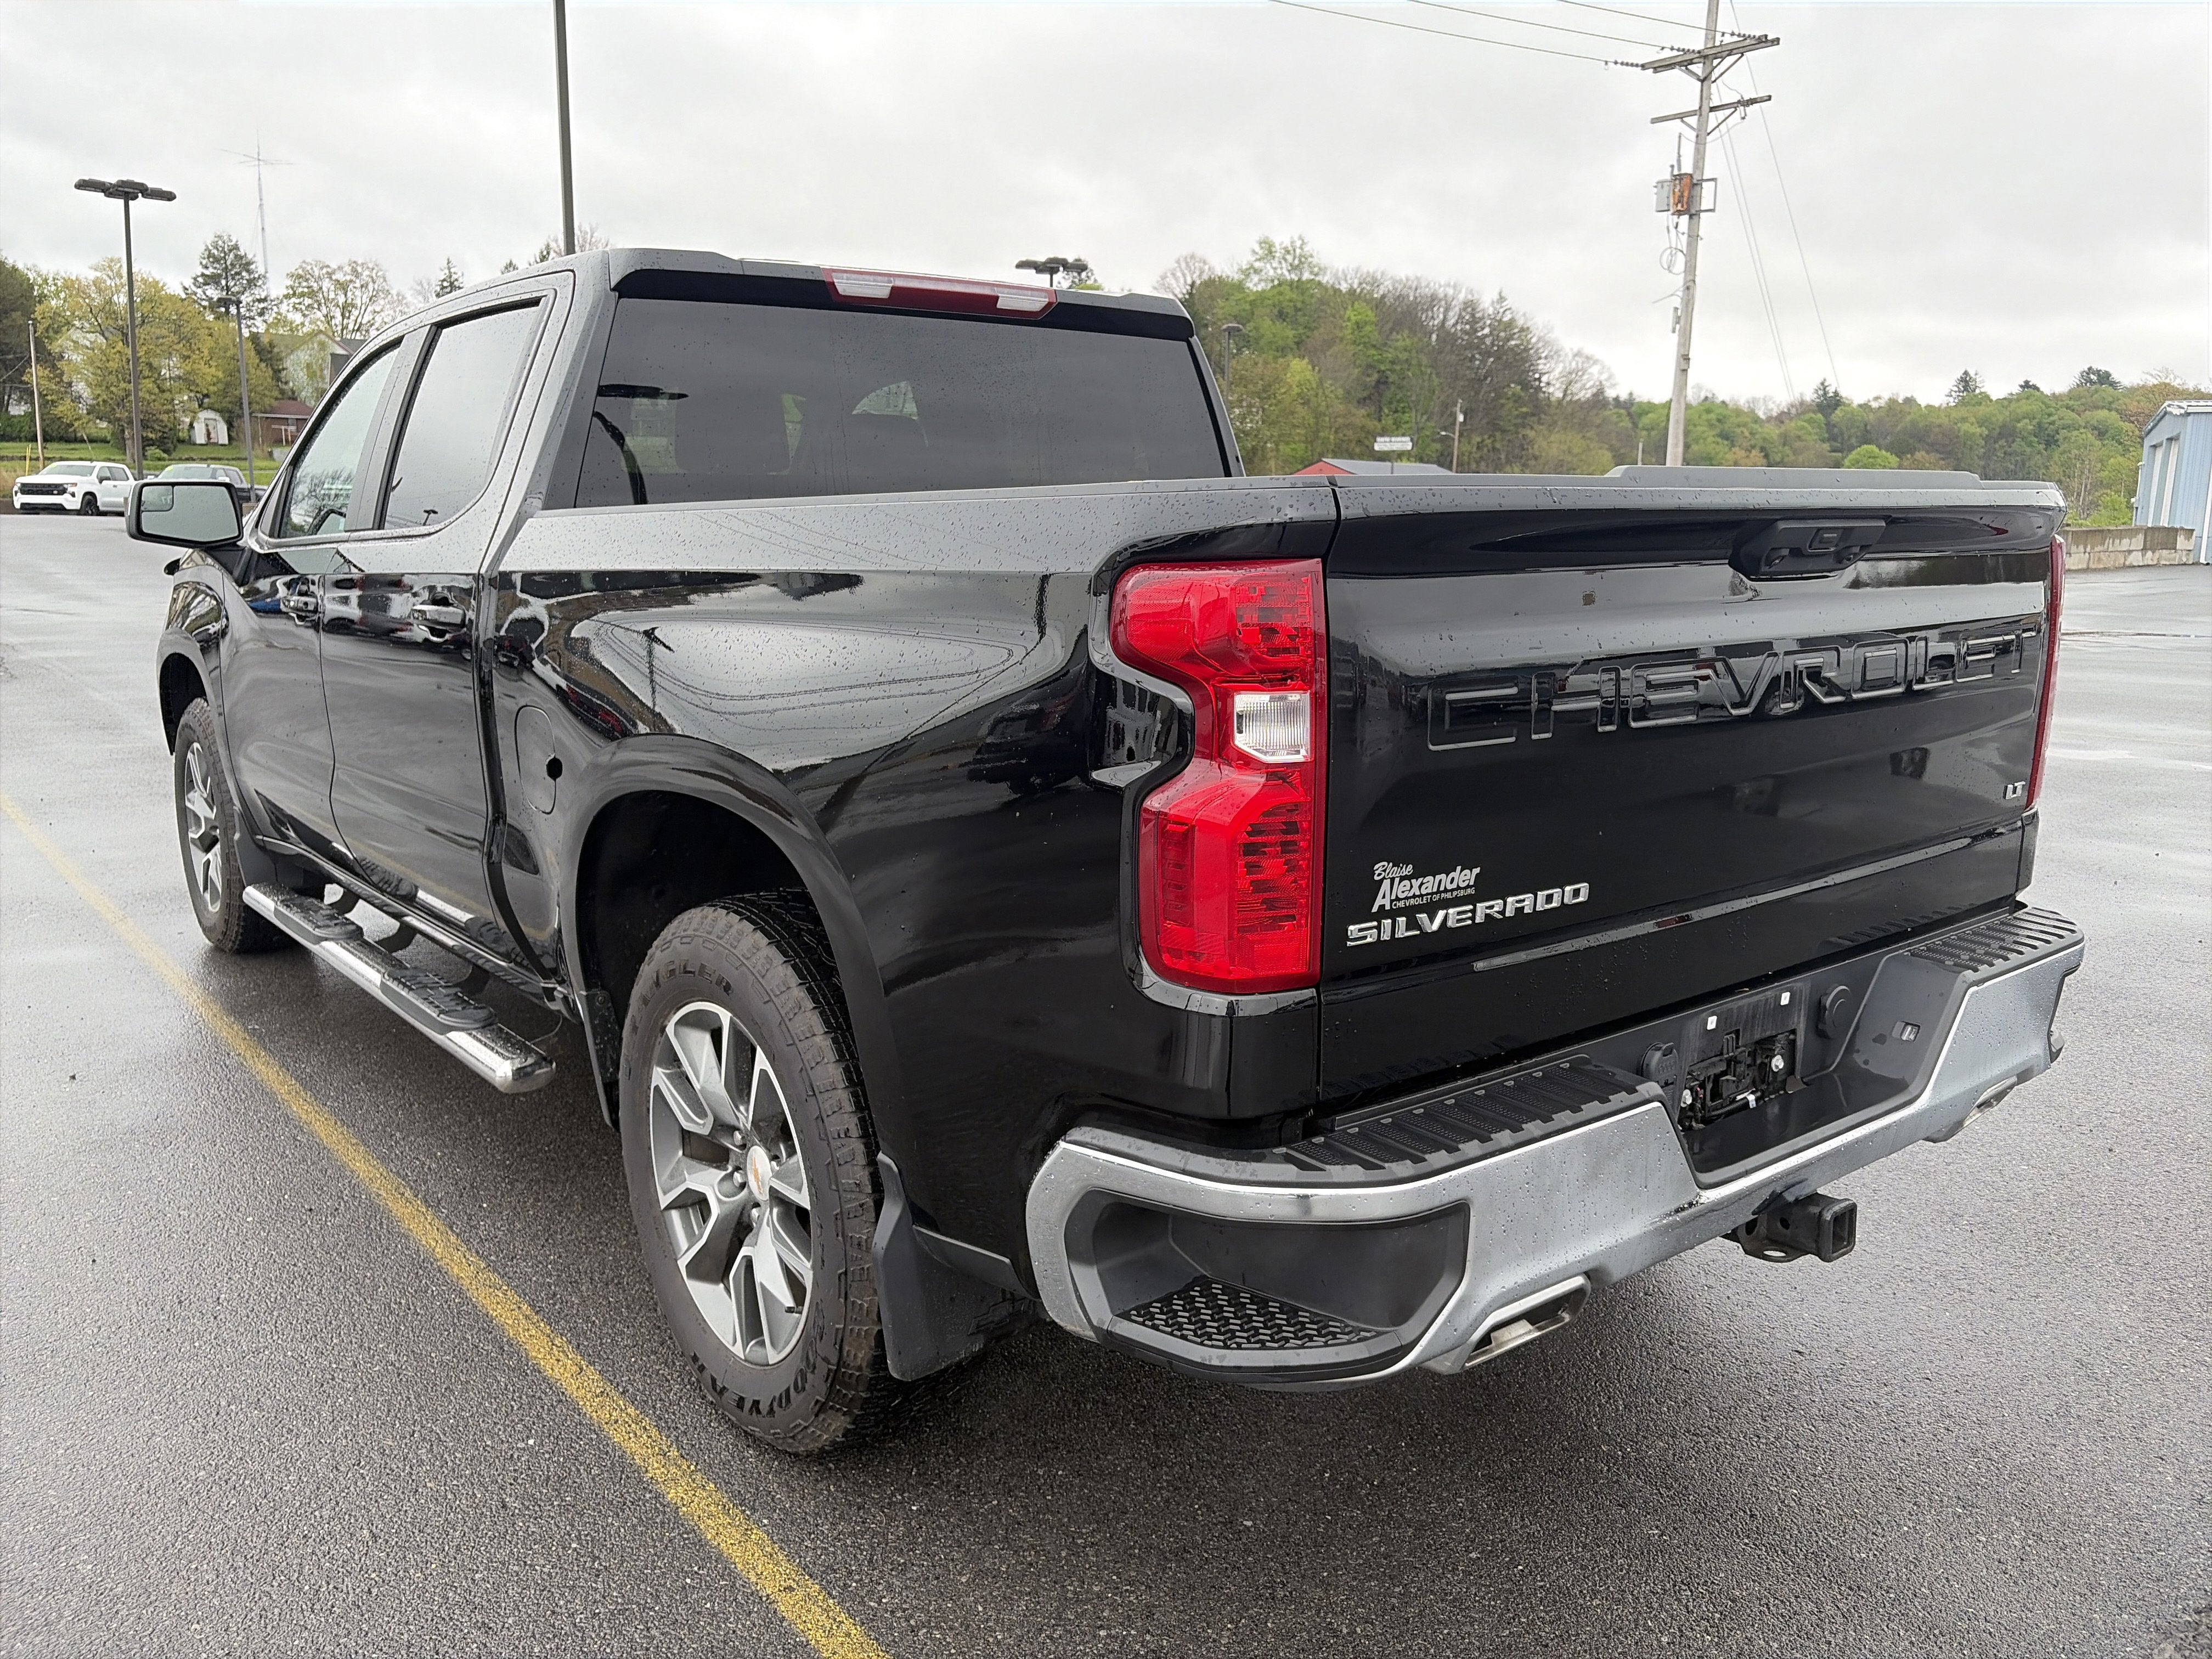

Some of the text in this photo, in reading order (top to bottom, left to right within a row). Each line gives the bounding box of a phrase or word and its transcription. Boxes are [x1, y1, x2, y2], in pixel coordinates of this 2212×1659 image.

[1428, 623, 2037, 751] CHEVROLET
[2004, 781, 2025, 799] LT
[1374, 861, 1414, 880] Blaise
[1372, 866, 1481, 912] Alexander
[1392, 896, 1431, 909] CHEVROLET
[1441, 887, 1475, 900] PHILIPSBURG
[1346, 882, 1590, 947] SILVERADO
